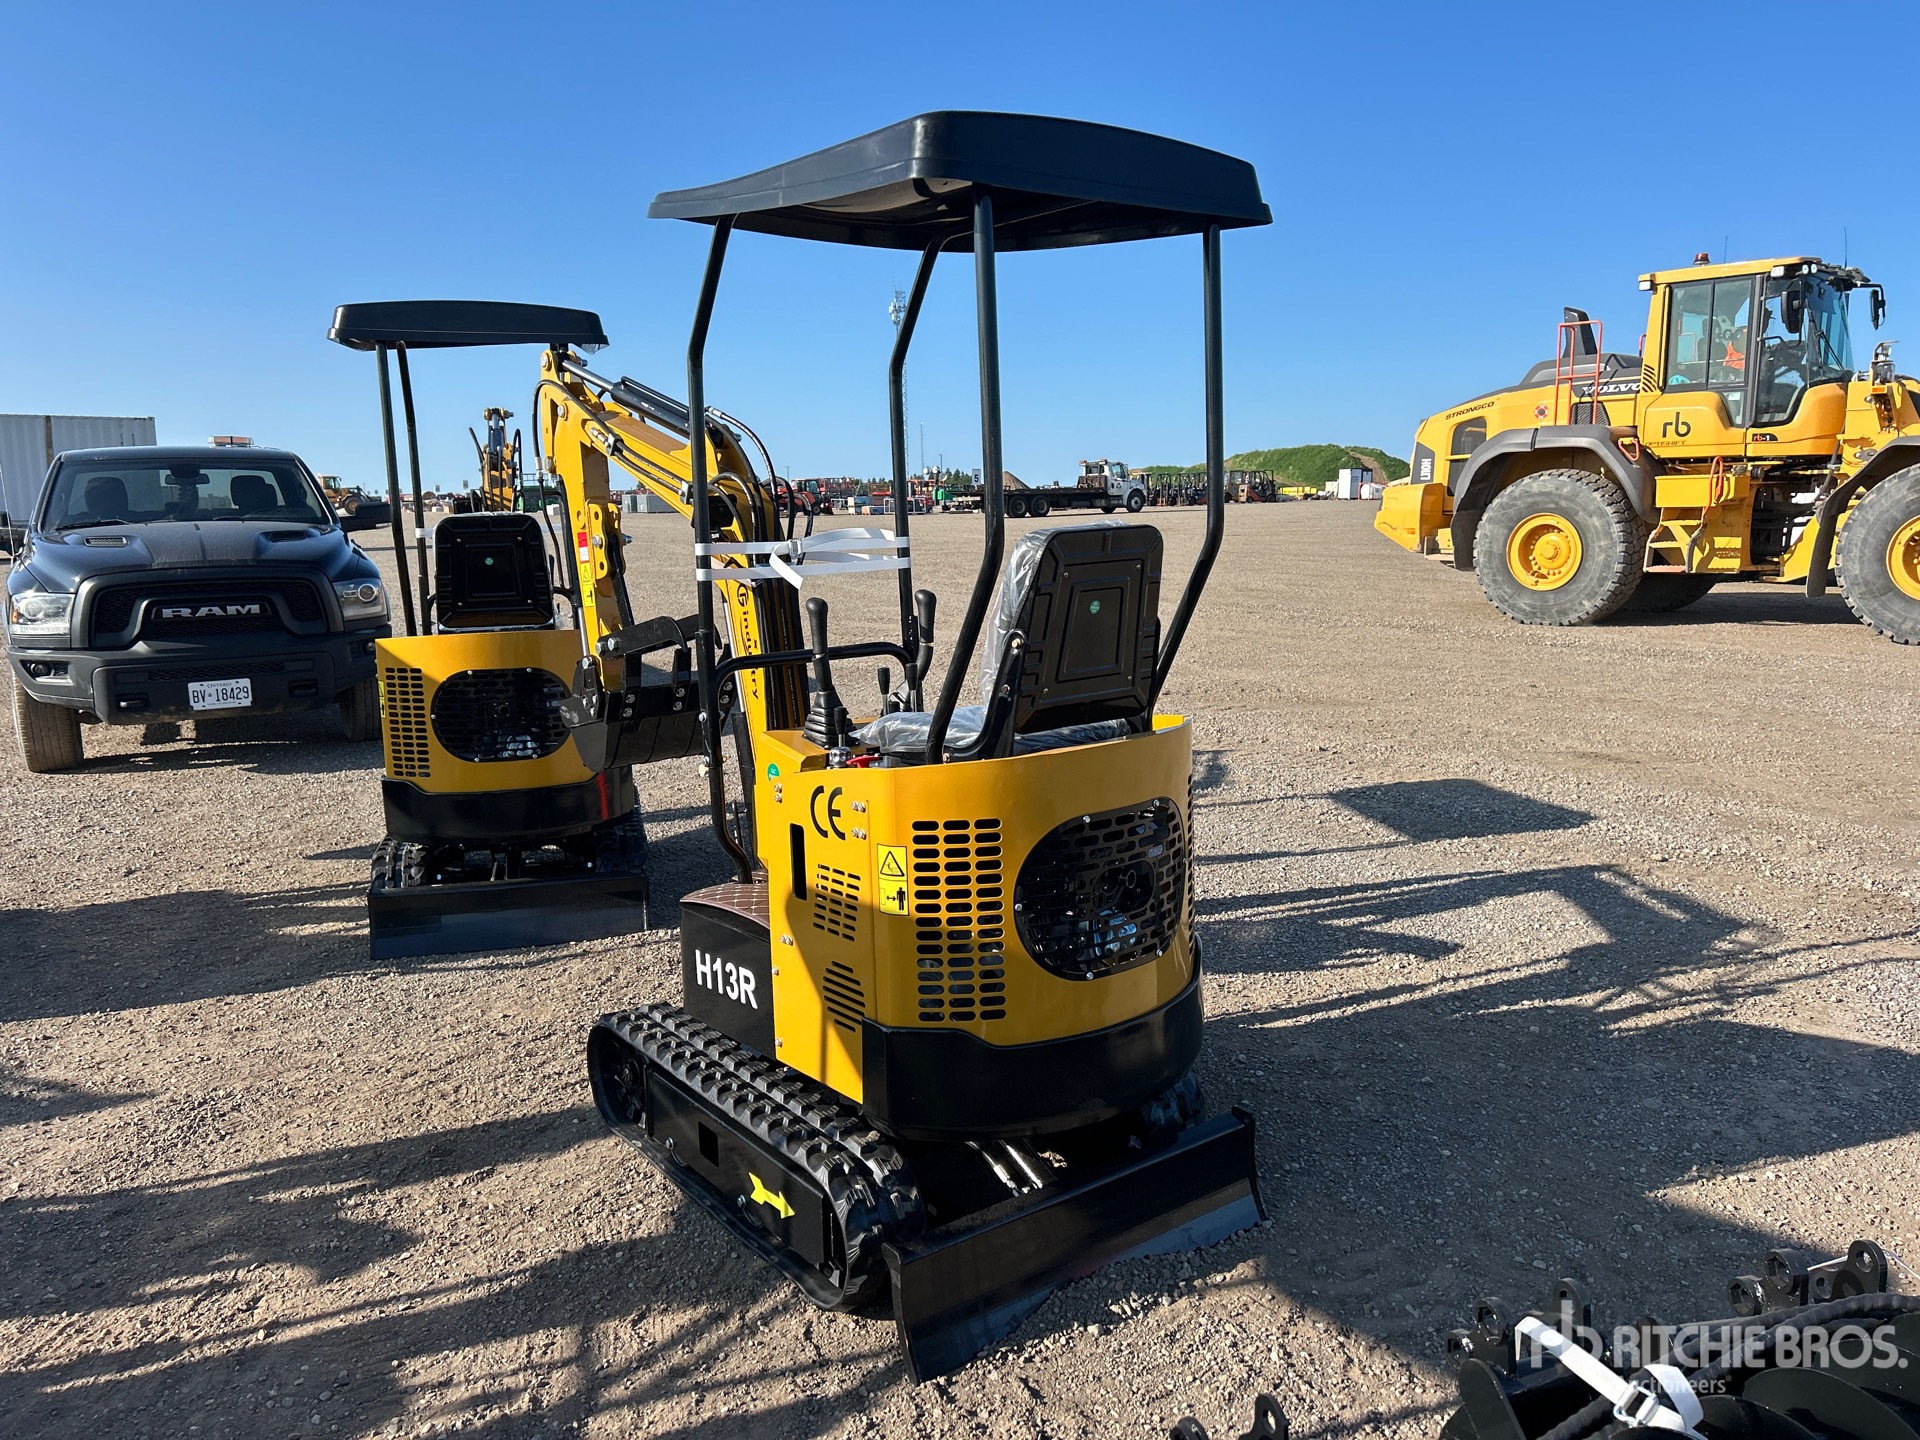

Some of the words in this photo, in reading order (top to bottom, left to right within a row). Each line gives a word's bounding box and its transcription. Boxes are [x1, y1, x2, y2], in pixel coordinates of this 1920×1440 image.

[1582, 382, 1641, 395] VOLVO
[1445, 401, 1495, 420] STRONGCO
[1662, 411, 1691, 438] rb
[973, 473, 979, 483] 5
[162, 604, 260, 619] RAM
[192, 689, 206, 704] BV
[215, 685, 250, 702] 18429
[810, 785, 846, 841] CE
[695, 949, 759, 1010] H13R
